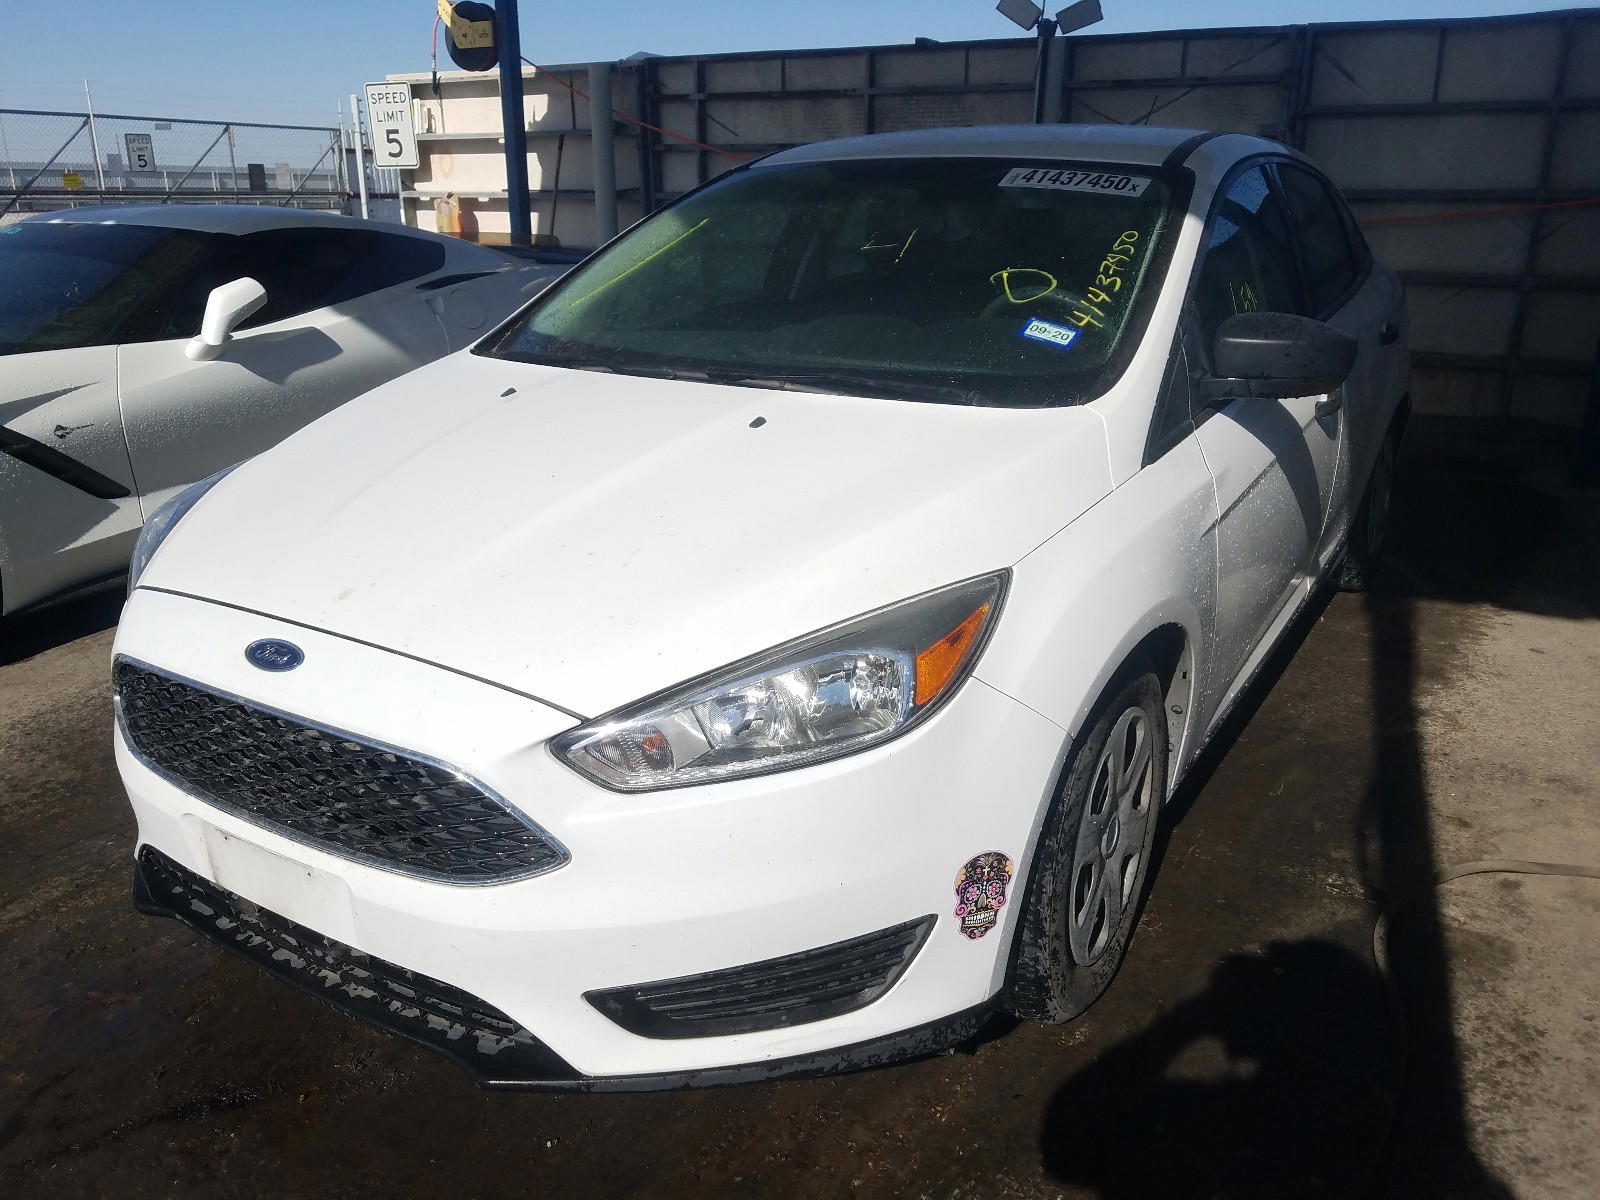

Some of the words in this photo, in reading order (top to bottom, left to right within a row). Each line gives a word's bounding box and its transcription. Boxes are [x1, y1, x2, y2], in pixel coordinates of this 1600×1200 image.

[370, 91, 407, 105] SPEED
[376, 110, 405, 123] LIMIT
[128, 137, 150, 145] SPEED
[385, 128, 404, 158] 5
[137, 154, 148, 168] 5
[1030, 324, 1047, 335] 09
[1051, 330, 1070, 341] 20
[254, 643, 292, 665] Ford
